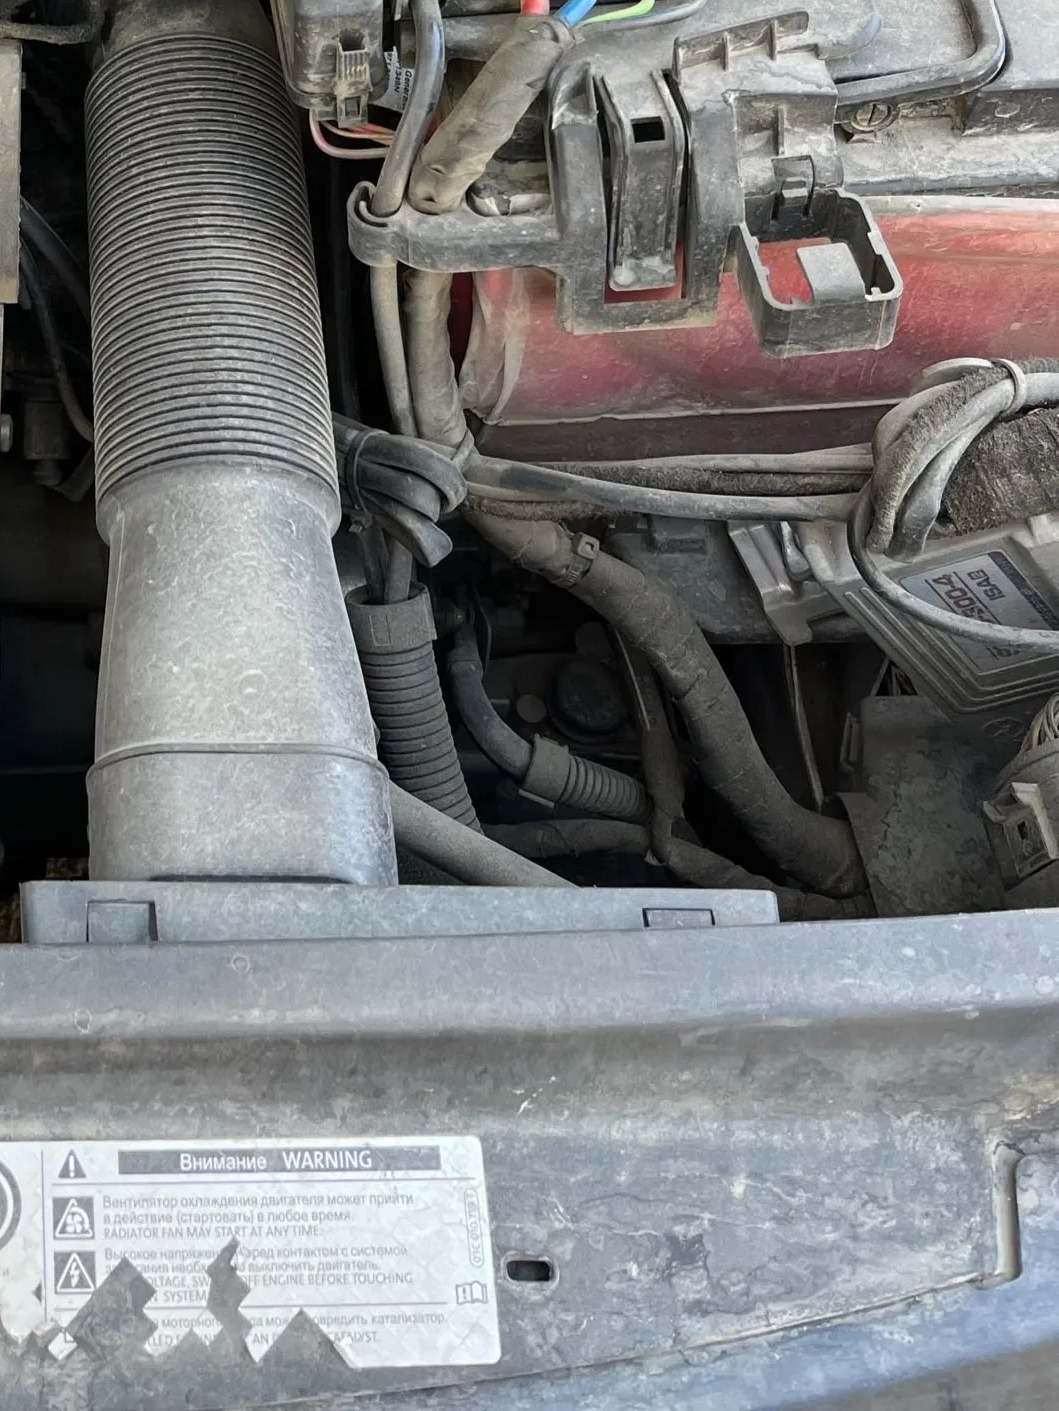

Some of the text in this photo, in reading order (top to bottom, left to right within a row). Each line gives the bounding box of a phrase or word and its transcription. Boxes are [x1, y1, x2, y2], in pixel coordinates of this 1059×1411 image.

[180, 1150, 373, 1171] Внимание WARNING
[102, 1192, 414, 1210] Вентилятор охлаждения двигателя может прийти
[103, 1214, 111, 1224] в
[113, 1211, 173, 1226] действие
[256, 1213, 264, 1222] в
[267, 1209, 309, 1222] любое
[104, 1227, 159, 1239] RADIATOR
[162, 1227, 184, 1239] FAN
[186, 1226, 212, 1238] MAY
[214, 1226, 247, 1238] START
[250, 1226, 263, 1237] AT
[267, 1226, 289, 1237] ANY
[104, 1248, 158, 1260] Высокое
[277, 1246, 338, 1258] контактом
[350, 1245, 408, 1257] системой
[249, 1259, 315, 1273] выключить
[263, 1274, 305, 1286] ENGINE
[308, 1273, 348, 1285] BEFORE
[352, 1272, 413, 1285] TOUCHING
